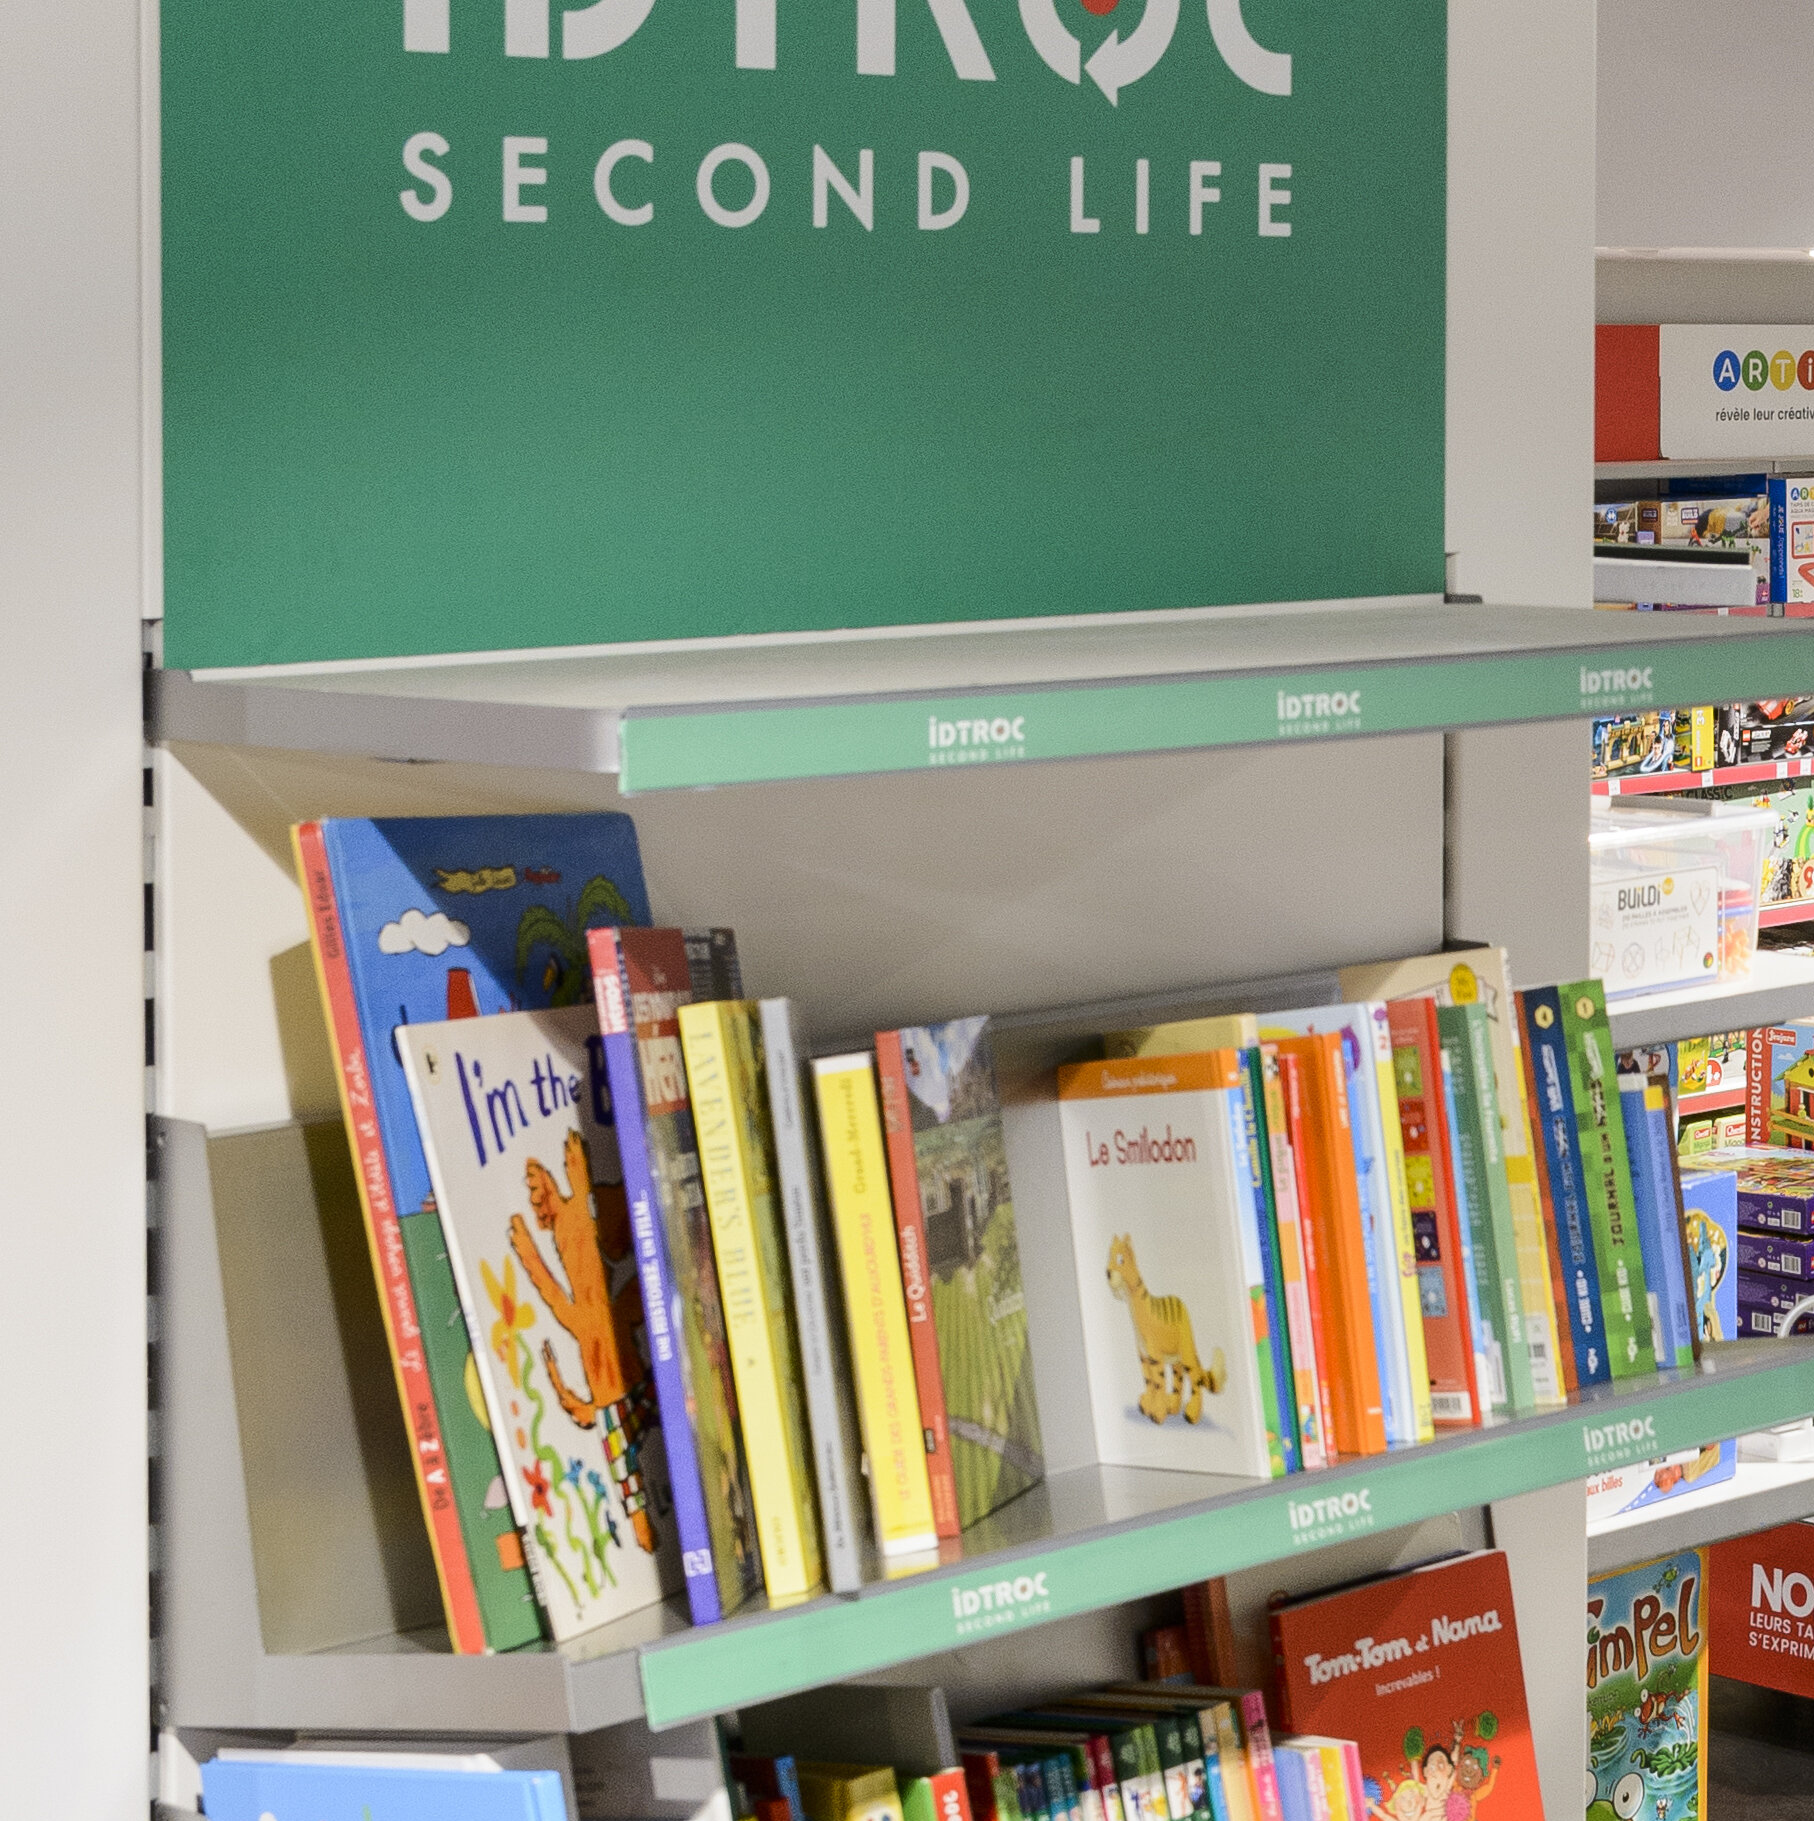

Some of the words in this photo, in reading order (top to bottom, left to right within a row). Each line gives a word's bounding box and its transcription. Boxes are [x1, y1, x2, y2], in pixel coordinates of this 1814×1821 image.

[399, 131, 972, 233] SECOND
[1068, 154, 1293, 237] LIFE
[1715, 407, 1750, 421] révèle
[1753, 407, 1774, 421] leur
[530, 1053, 581, 1118] the
[1087, 1133, 1108, 1168] Le
[1115, 1125, 1196, 1165] Smilodon
[897, 1224, 927, 1302] Quidditch
[907, 1301, 928, 1323] Le
[1431, 1609, 1503, 1648] Nana
[1749, 1611, 1792, 1634] LEURS
[1375, 1670, 1434, 1698] Increvables
